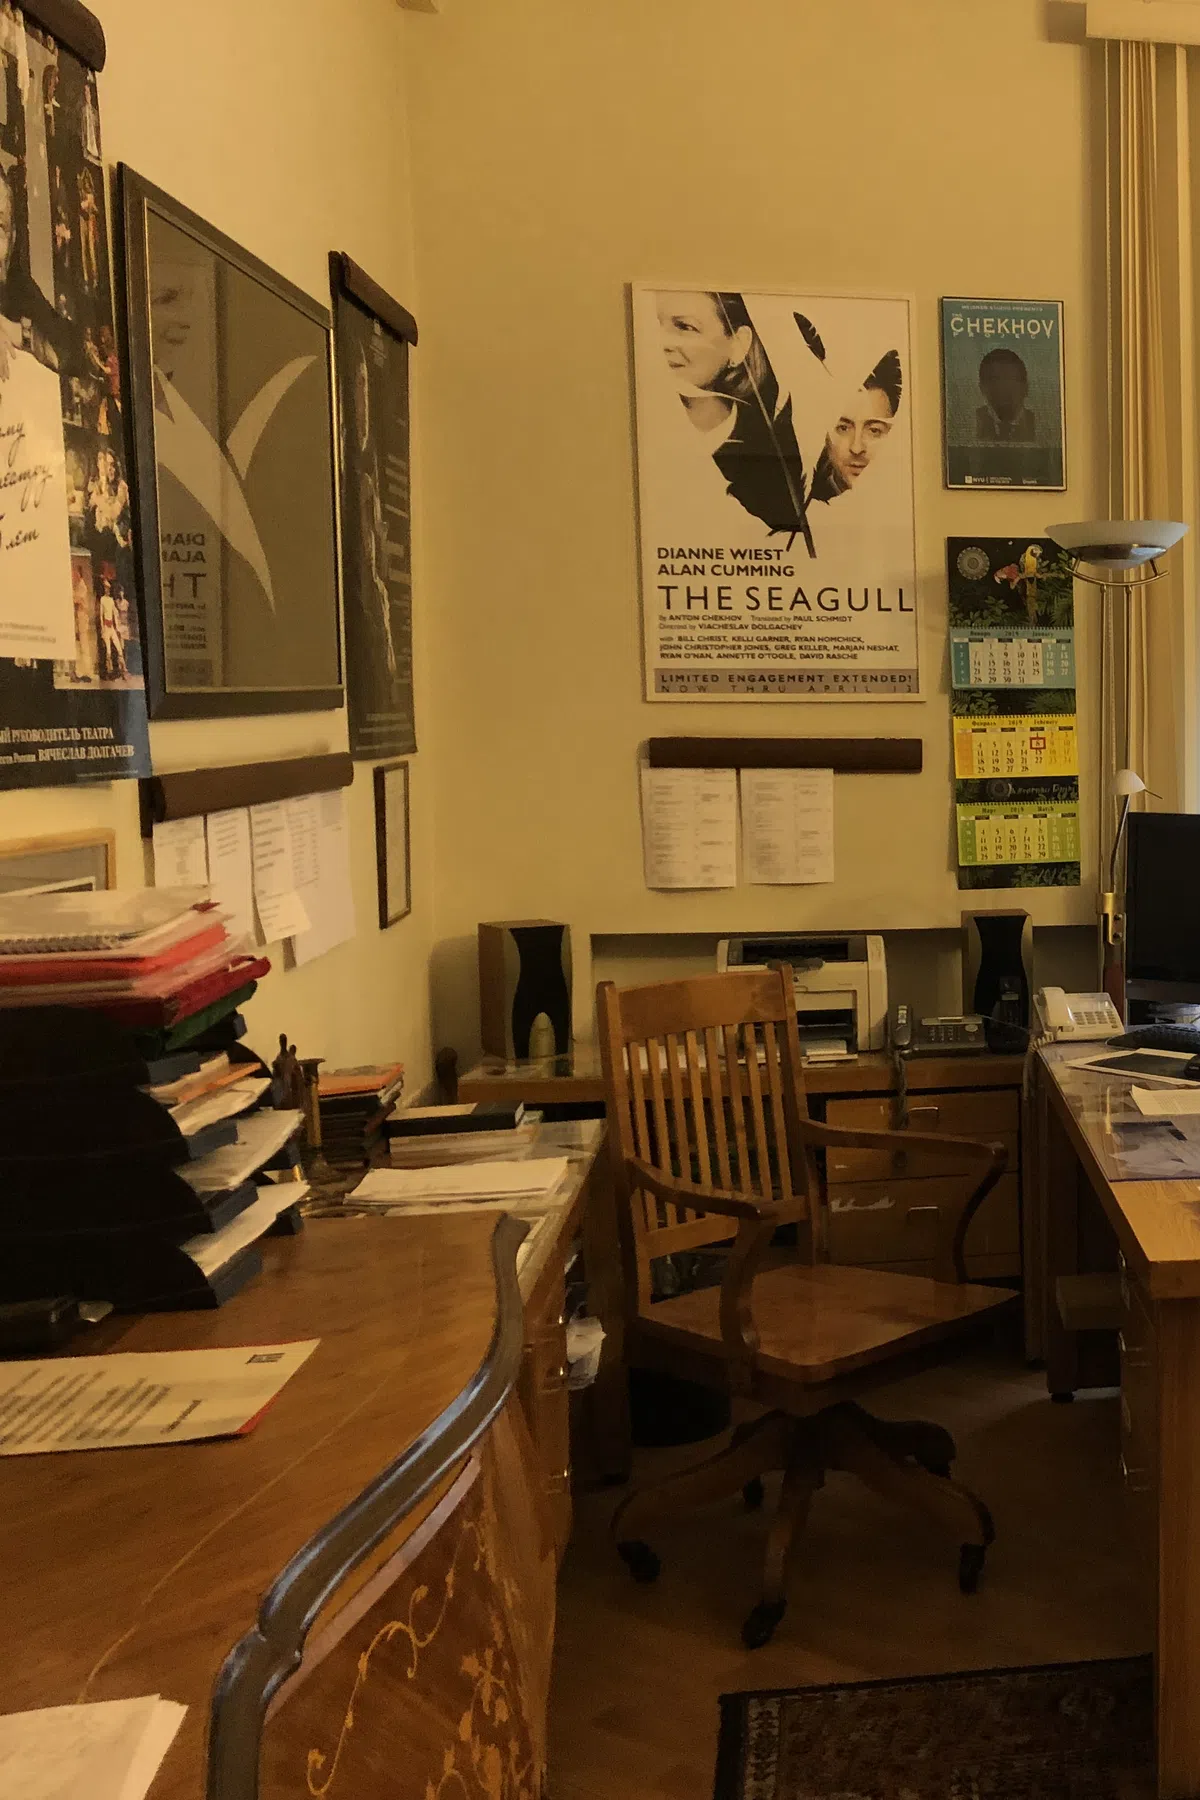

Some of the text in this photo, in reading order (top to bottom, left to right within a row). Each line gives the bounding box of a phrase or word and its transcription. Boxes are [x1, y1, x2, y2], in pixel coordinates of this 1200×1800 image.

[950, 317, 1054, 335] CHEKHOV
[657, 547, 784, 560] DIANNE WIEST
[657, 564, 795, 577] ALAN CUMMING
[657, 586, 914, 612] THE SEAGULL
[818, 636, 865, 644] HOMCHICK,
[744, 644, 772, 652] JONES,
[974, 668, 980, 676] 21
[988, 668, 996, 676] 22
[1003, 668, 1011, 676] 23
[1018, 668, 1026, 676] 24
[1032, 668, 1040, 676] 25
[661, 674, 912, 682] LIMITED ENGAGEMENT EXTENDED!
[974, 676, 1024, 684] 28 29 30 31
[661, 685, 912, 693] NOW THRU APRIL 13
[12, 727, 80, 743] РУКОВОДИТЕЛЬ
[82, 727, 114, 740] ТЕАТРА
[38, 747, 86, 761] ВЯЧЕСЛАВ
[87, 745, 134, 760] ДОЛГАЧЕВ
[994, 836, 1002, 844] 12
[1009, 844, 1017, 852] 20
